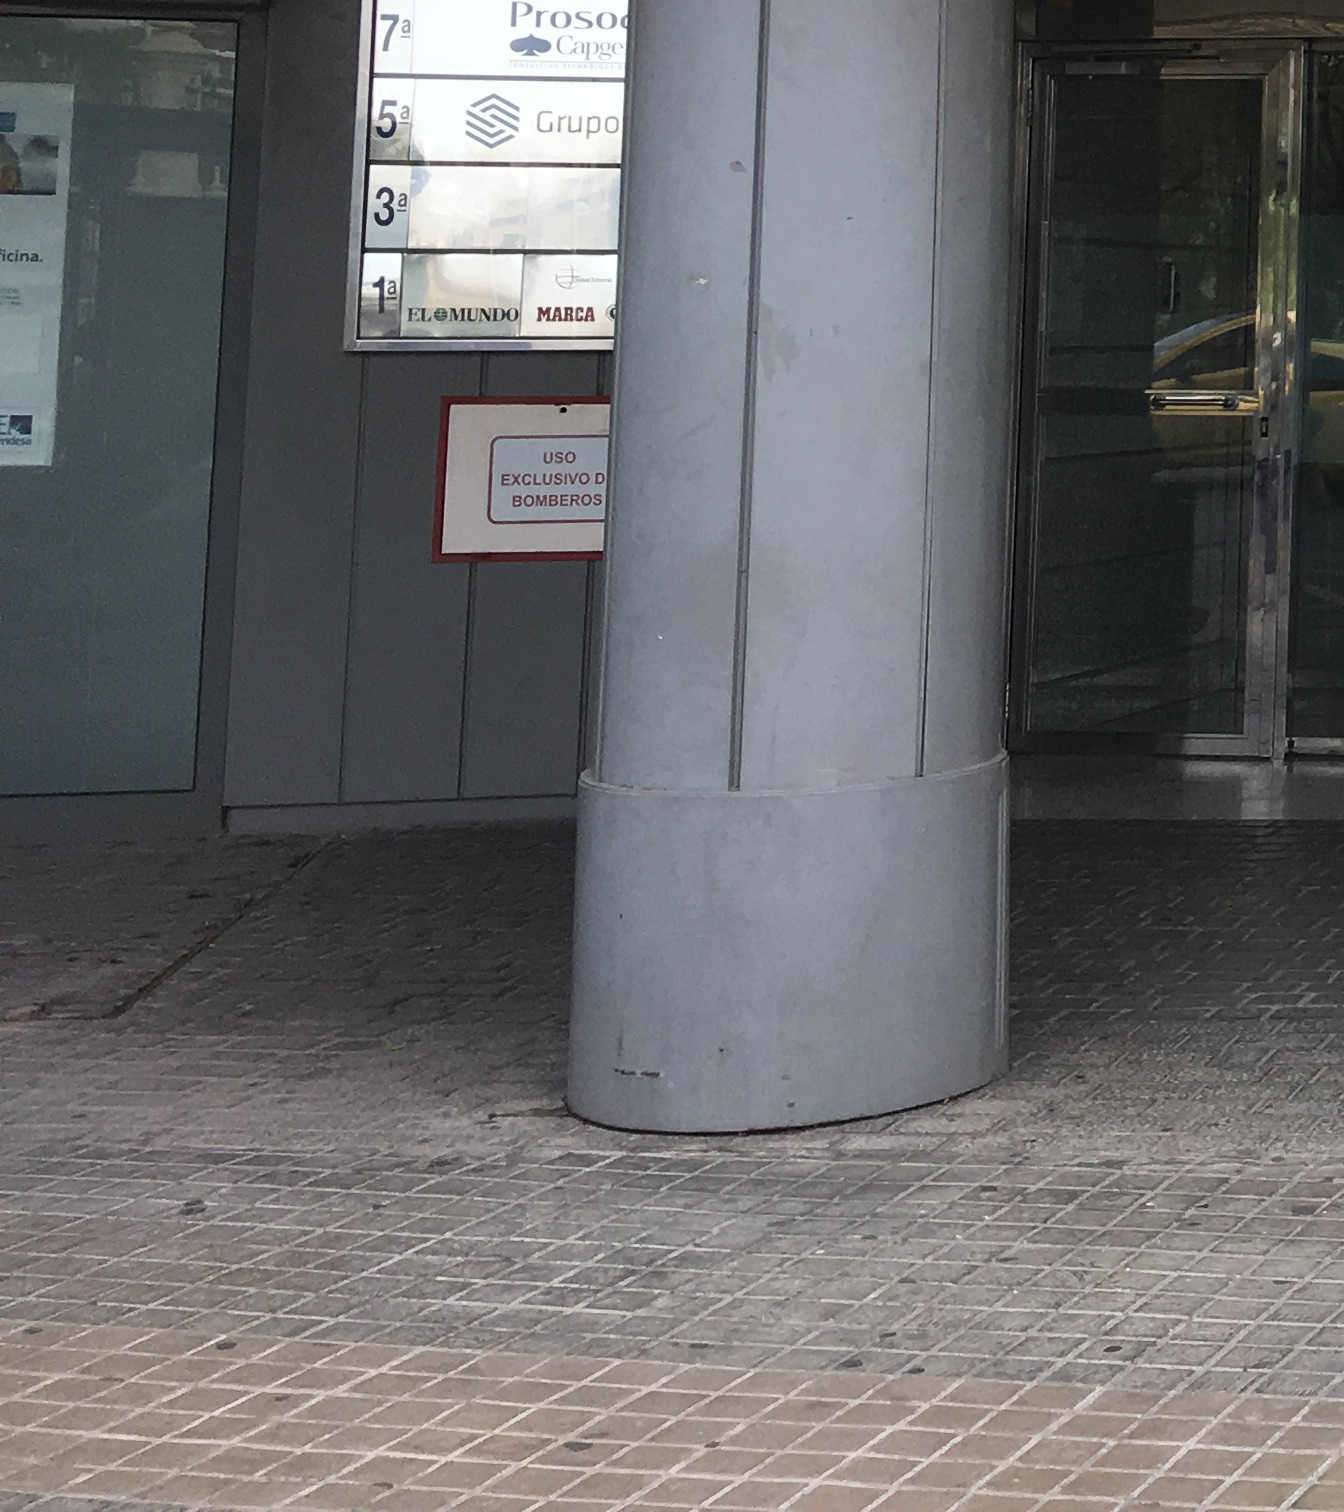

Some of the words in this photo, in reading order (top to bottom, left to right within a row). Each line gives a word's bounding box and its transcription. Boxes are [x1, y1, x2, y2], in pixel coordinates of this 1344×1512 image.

[407, 307, 432, 323] EL
[449, 306, 519, 323] MUNDO
[536, 306, 595, 323] MARCA
[543, 451, 577, 464] USO
[500, 472, 590, 486] EXCLUSIVO
[511, 493, 603, 507] BOMBEROS
